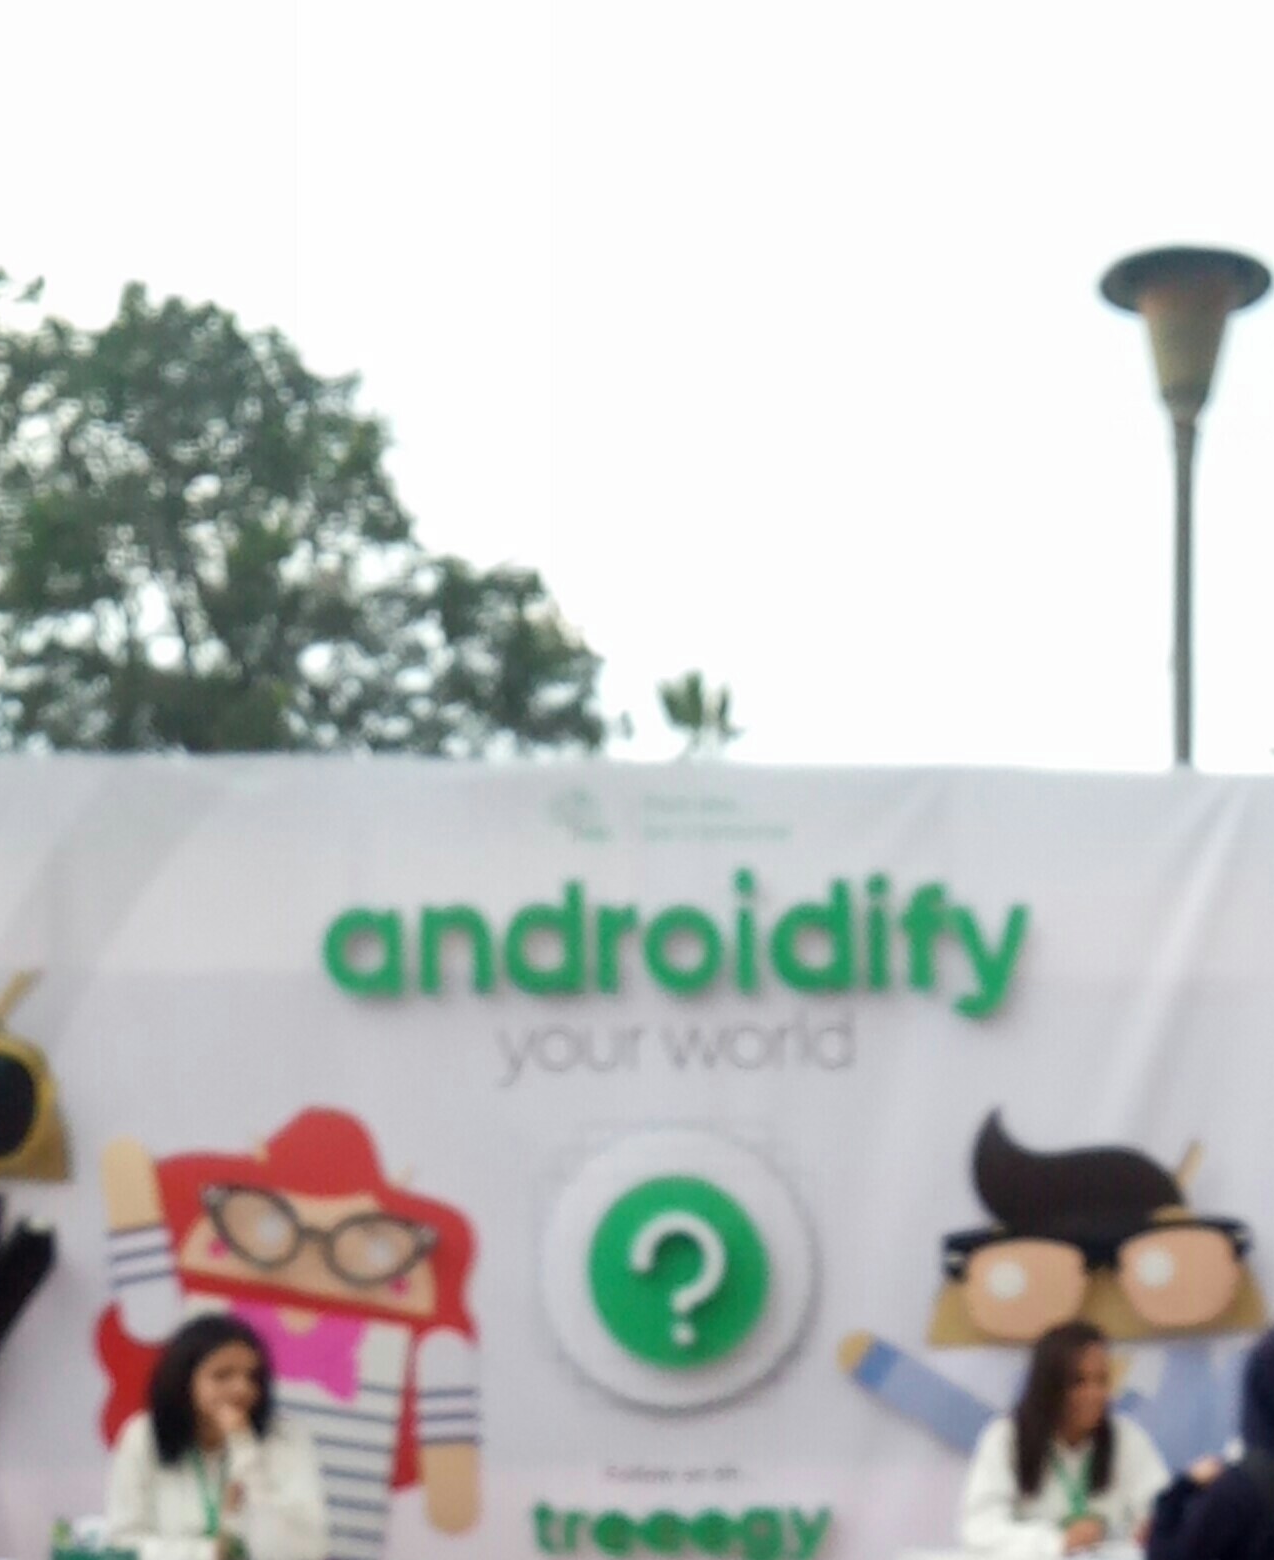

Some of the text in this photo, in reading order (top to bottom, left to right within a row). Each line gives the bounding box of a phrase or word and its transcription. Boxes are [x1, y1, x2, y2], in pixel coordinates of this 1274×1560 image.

[322, 868, 1031, 1018] androidify
[498, 1011, 855, 1087] your world
